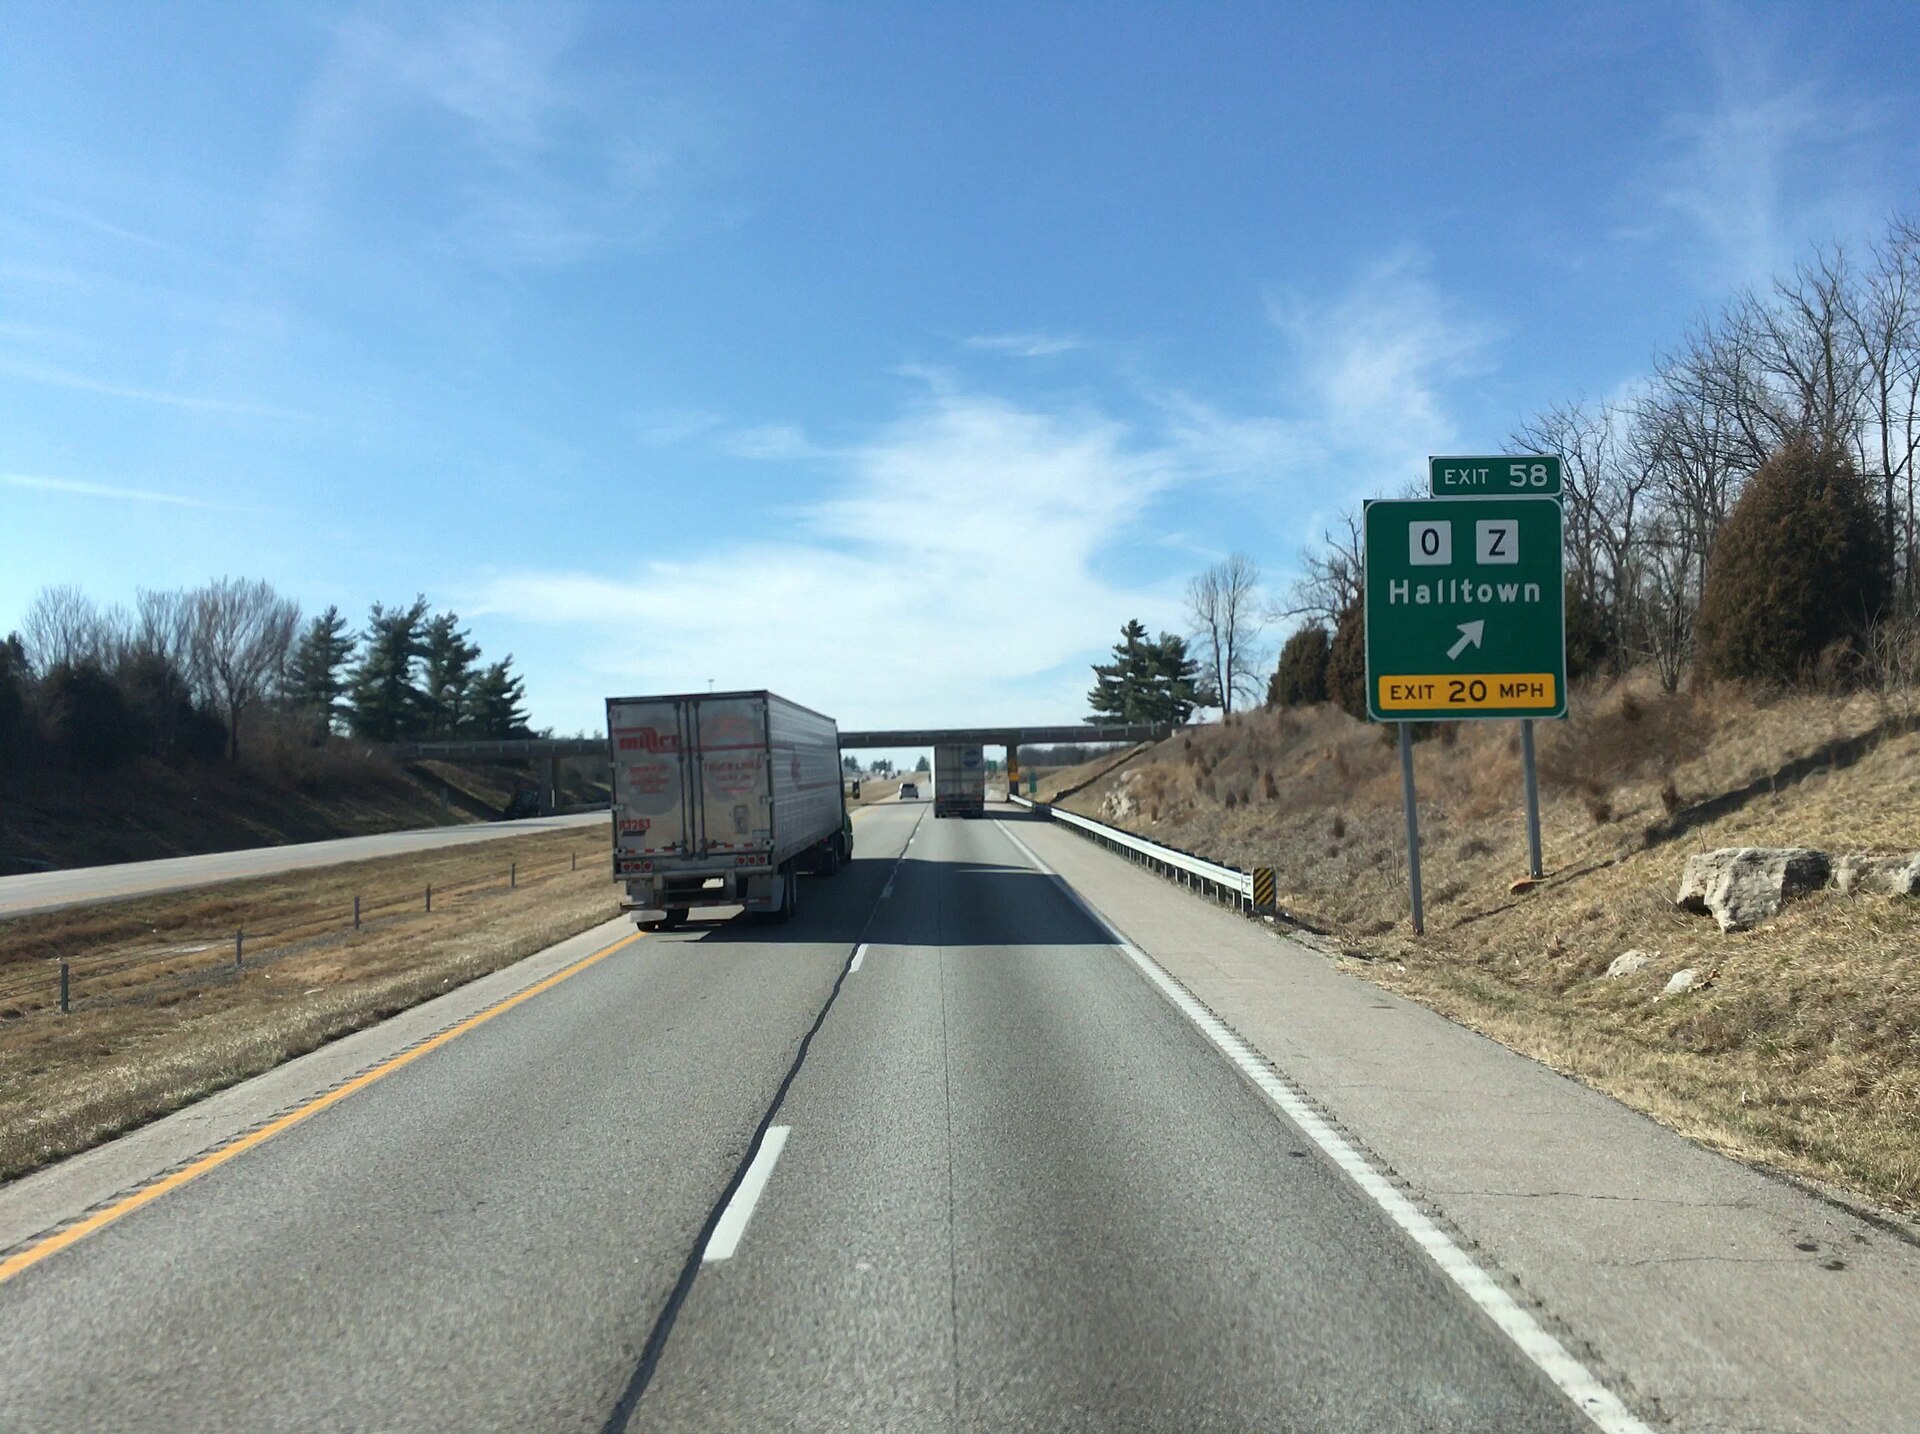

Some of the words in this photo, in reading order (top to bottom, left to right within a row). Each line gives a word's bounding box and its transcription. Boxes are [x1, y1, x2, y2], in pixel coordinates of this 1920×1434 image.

[1445, 469, 1489, 485] EXIT
[1510, 464, 1548, 487] 58
[1421, 528, 1439, 556] O
[1488, 528, 1506, 556] Z
[1389, 579, 1540, 604] Halltown
[1391, 684, 1435, 700] EXIT
[1449, 680, 1487, 703] 20
[1500, 683, 1543, 698] MPH
